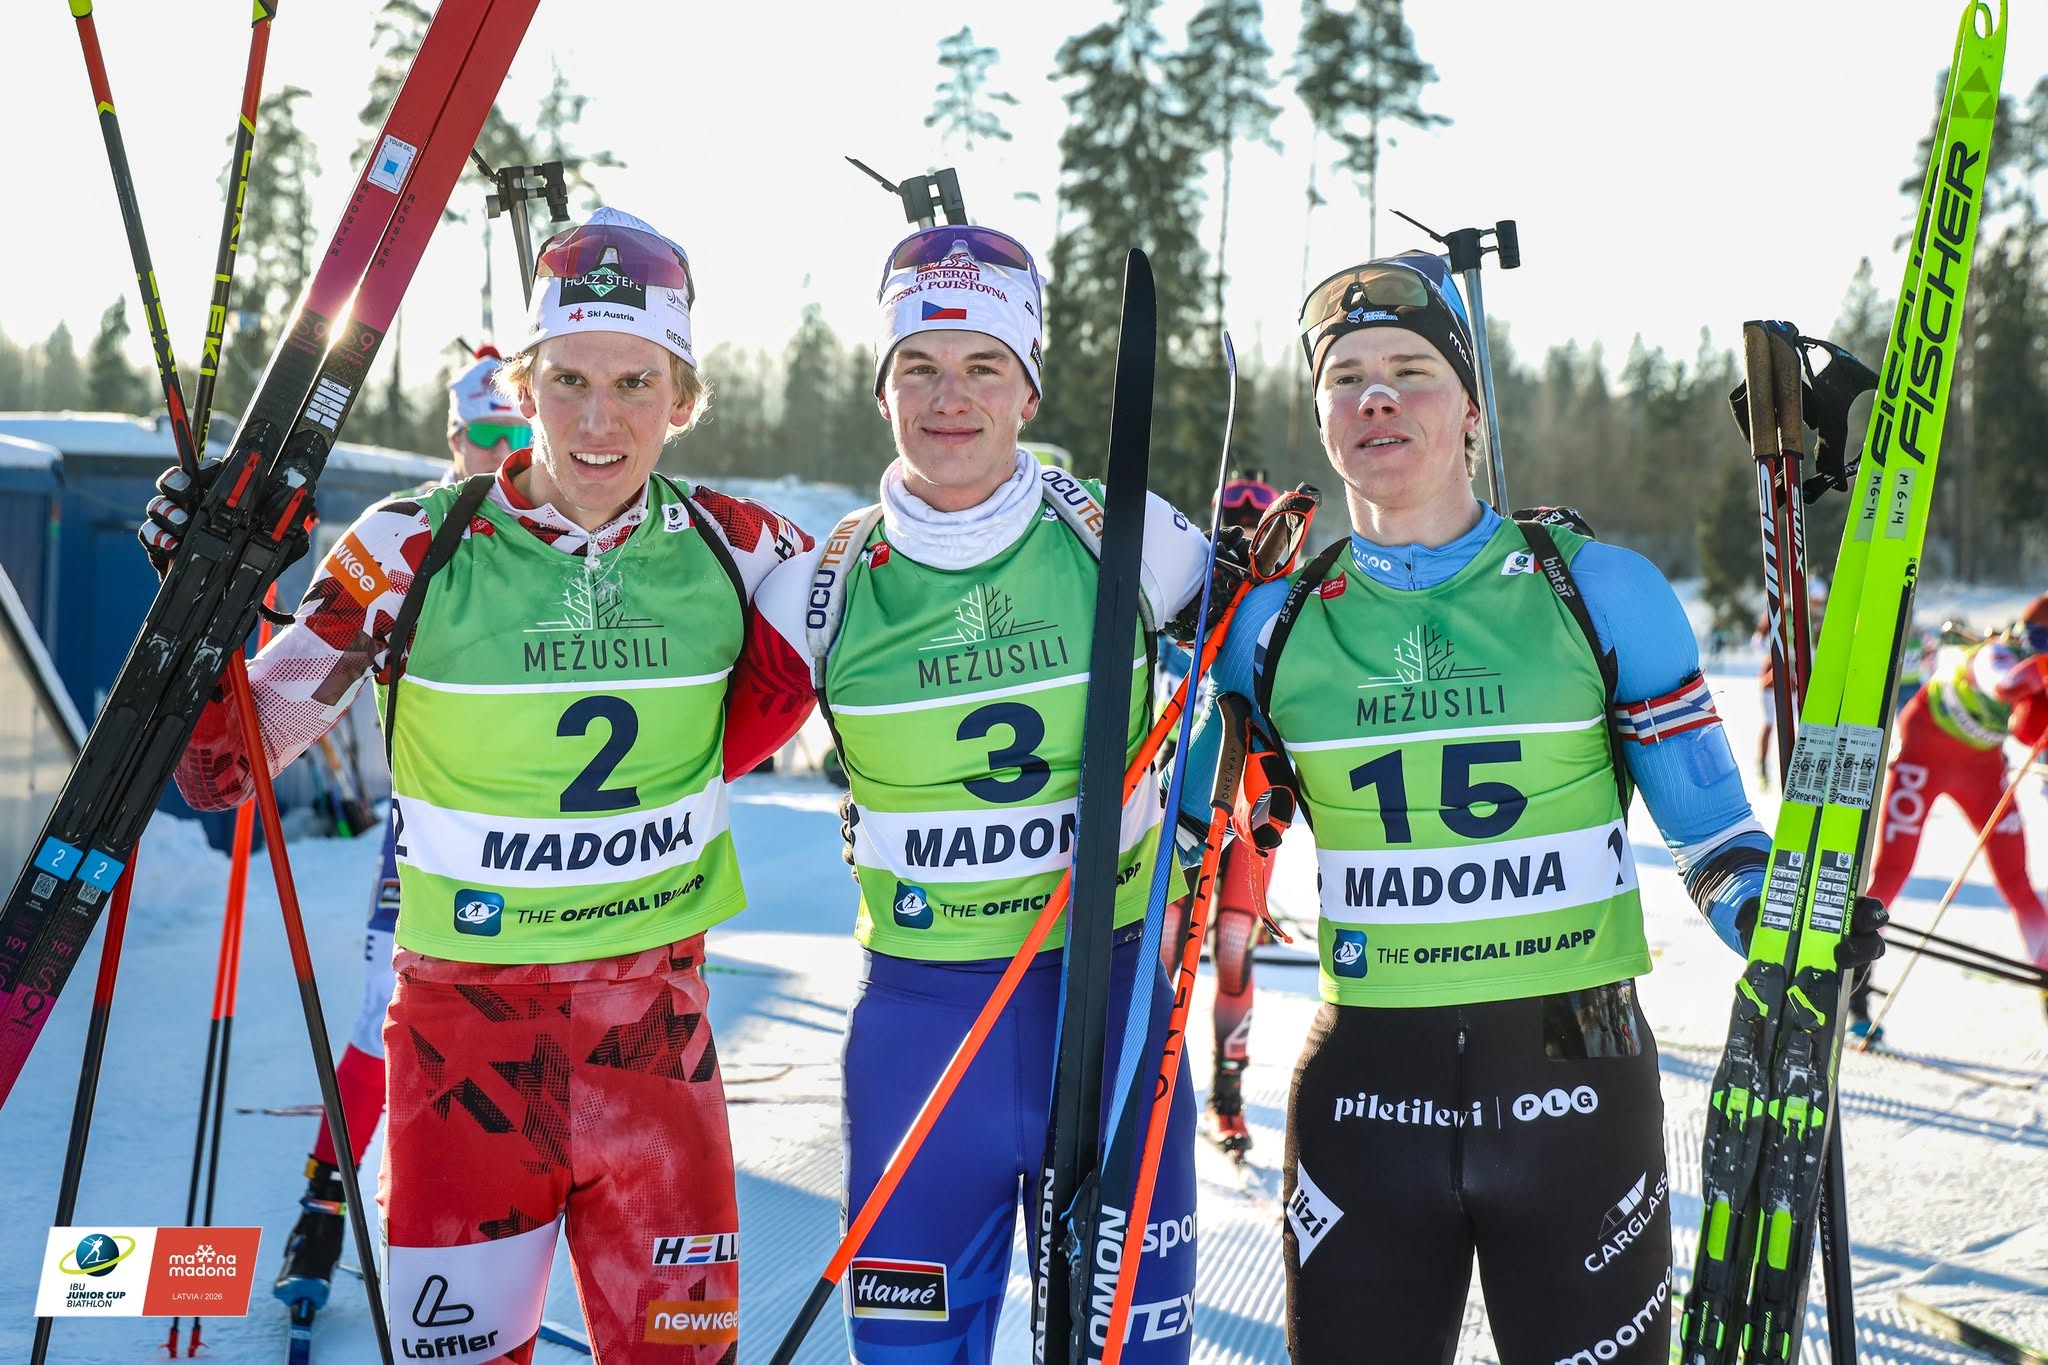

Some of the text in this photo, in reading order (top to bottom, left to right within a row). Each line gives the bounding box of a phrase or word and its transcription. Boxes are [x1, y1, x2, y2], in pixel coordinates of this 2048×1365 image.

[331, 183, 369, 257] REDSTER
[378, 194, 416, 268] REDSTER
[564, 274, 600, 289] HOLZ
[915, 270, 981, 283] GENERALI
[926, 279, 1009, 303] POJIŠŤOVNA
[200, 273, 231, 377] LEKI
[586, 310, 635, 323] Ski Austria
[1900, 141, 1980, 465] FISCHER
[806, 519, 861, 630] OCUTEIN
[523, 633, 668, 672] MEŽUSILI
[918, 635, 1069, 689] MEŽUSILI
[1356, 684, 1506, 727] MEŽUSILI
[556, 695, 641, 812] 2
[956, 701, 1051, 803] 3
[1348, 740, 1528, 844] 15
[1886, 763, 1929, 844] POL
[51, 848, 66, 868] 2
[481, 812, 693, 871] MADONA
[93, 861, 109, 881] 2
[1345, 851, 1567, 907] MADONA
[517, 908, 557, 924] THE
[560, 896, 650, 922] OFFICIAL
[940, 903, 977, 918] THE
[1377, 928, 1597, 964] THE OFFICIAL IBU APP
[1515, 1088, 1596, 1119] PLG
[1292, 1189, 1329, 1240] iizi
[1583, 1171, 1669, 1273] CARGLASS
[857, 1273, 937, 1306] Hamé
[402, 1330, 499, 1360] Löffler
